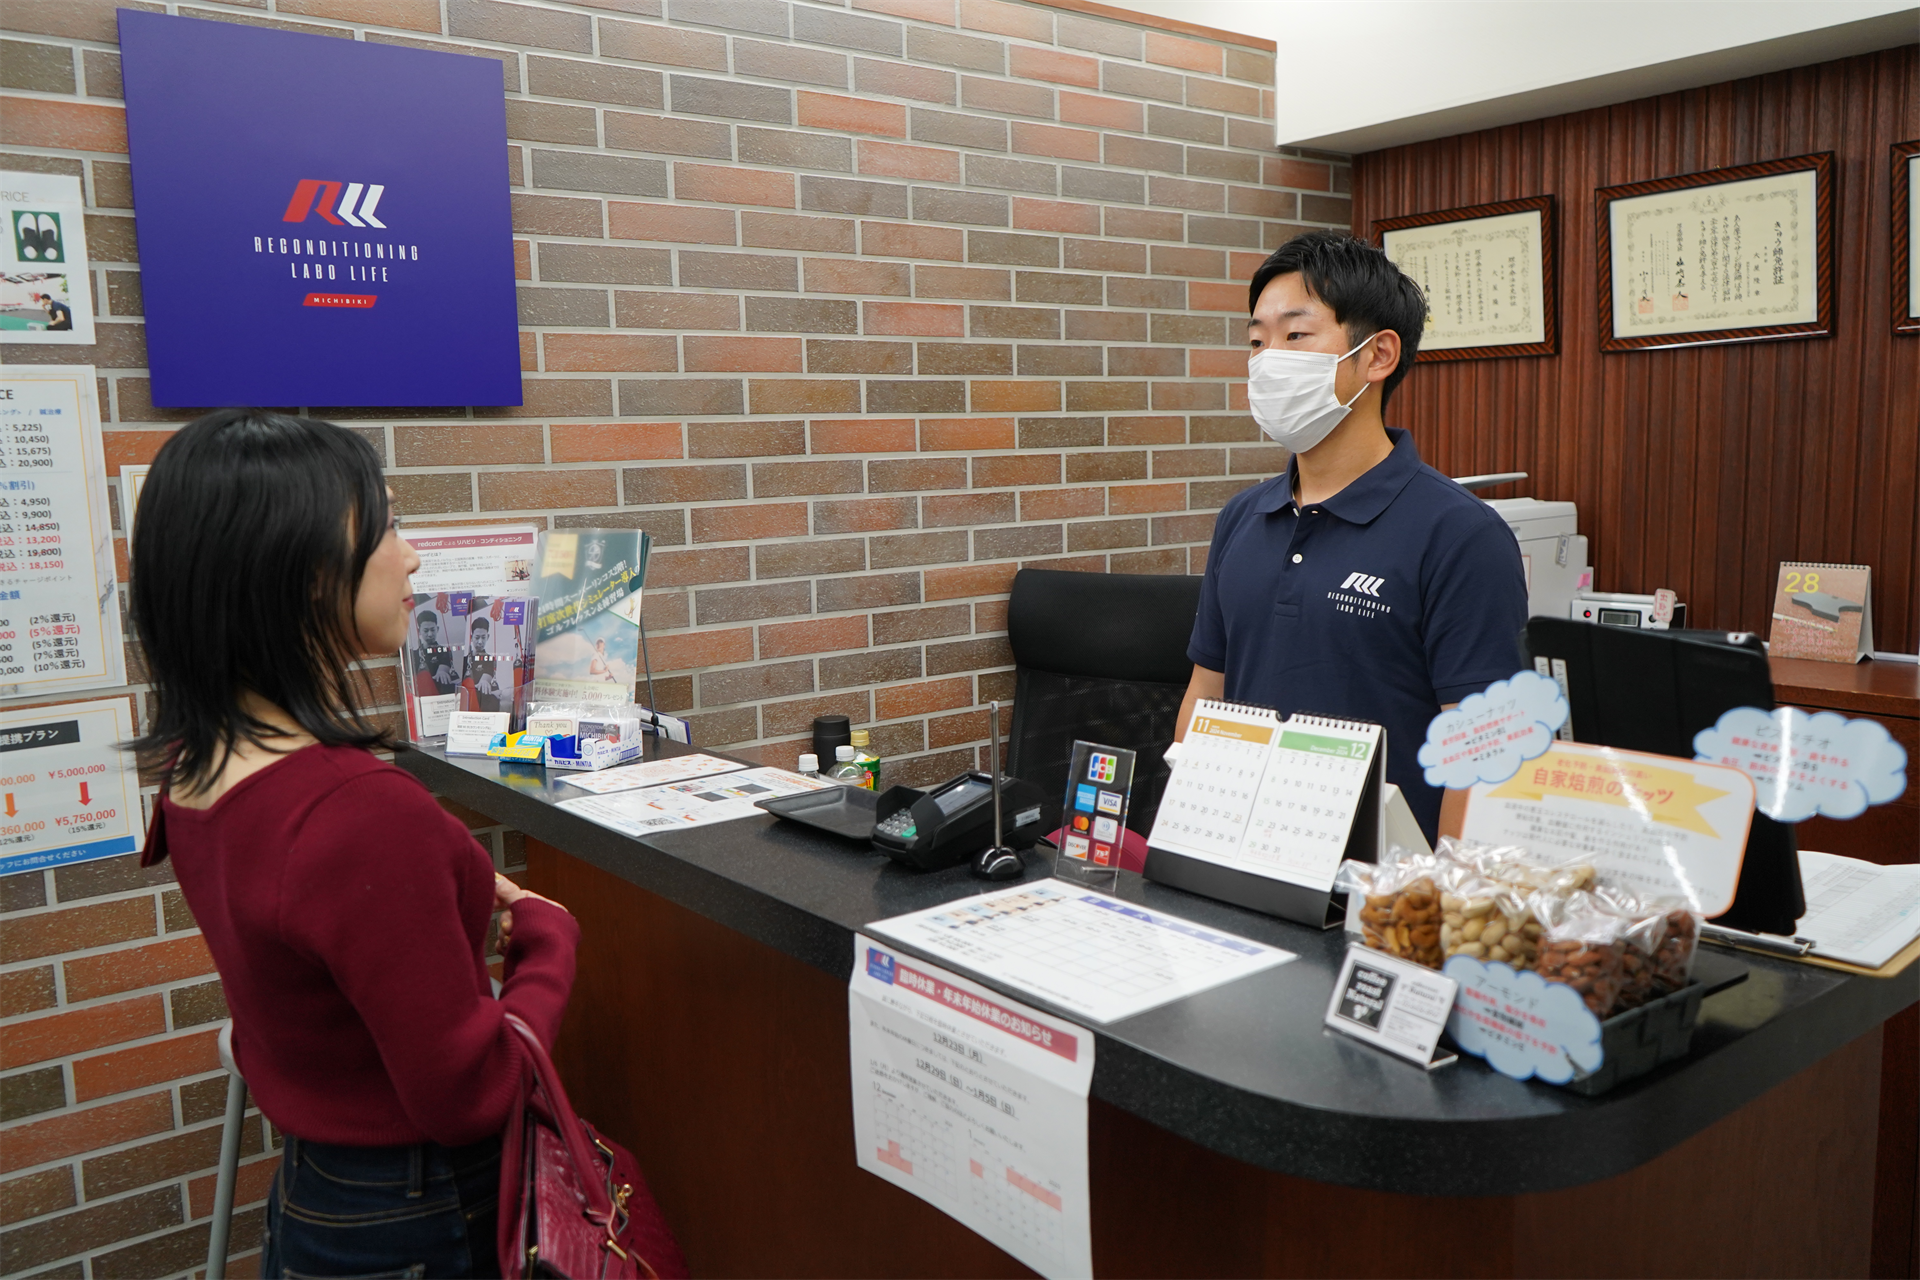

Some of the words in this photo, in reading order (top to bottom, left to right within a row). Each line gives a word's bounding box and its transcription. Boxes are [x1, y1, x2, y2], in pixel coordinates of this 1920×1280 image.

[254, 236, 418, 261] RECONDITIONING
[291, 263, 336, 280] LABO
[350, 265, 388, 282] LIFE
[313, 297, 367, 305] MICHIBIKI
[0, 423, 42, 432] ：5,225)
[0, 522, 60, 533] 込：14,850)
[1784, 572, 1820, 594] 28
[1446, 698, 1516, 734] カシューナッツ
[1197, 718, 1210, 732] 11
[1350, 742, 1366, 758] 12
[1091, 761, 1114, 774] JCB
[0, 774, 36, 786] 00,000
[1103, 796, 1118, 808] VISA
[55, 809, 116, 827] ¥5,750,000
[1476, 974, 1540, 1010] アーモンド
[900, 968, 1052, 1047] 臨時休業・年末年始休業のお知らせ
[872, 1080, 881, 1092] 12
